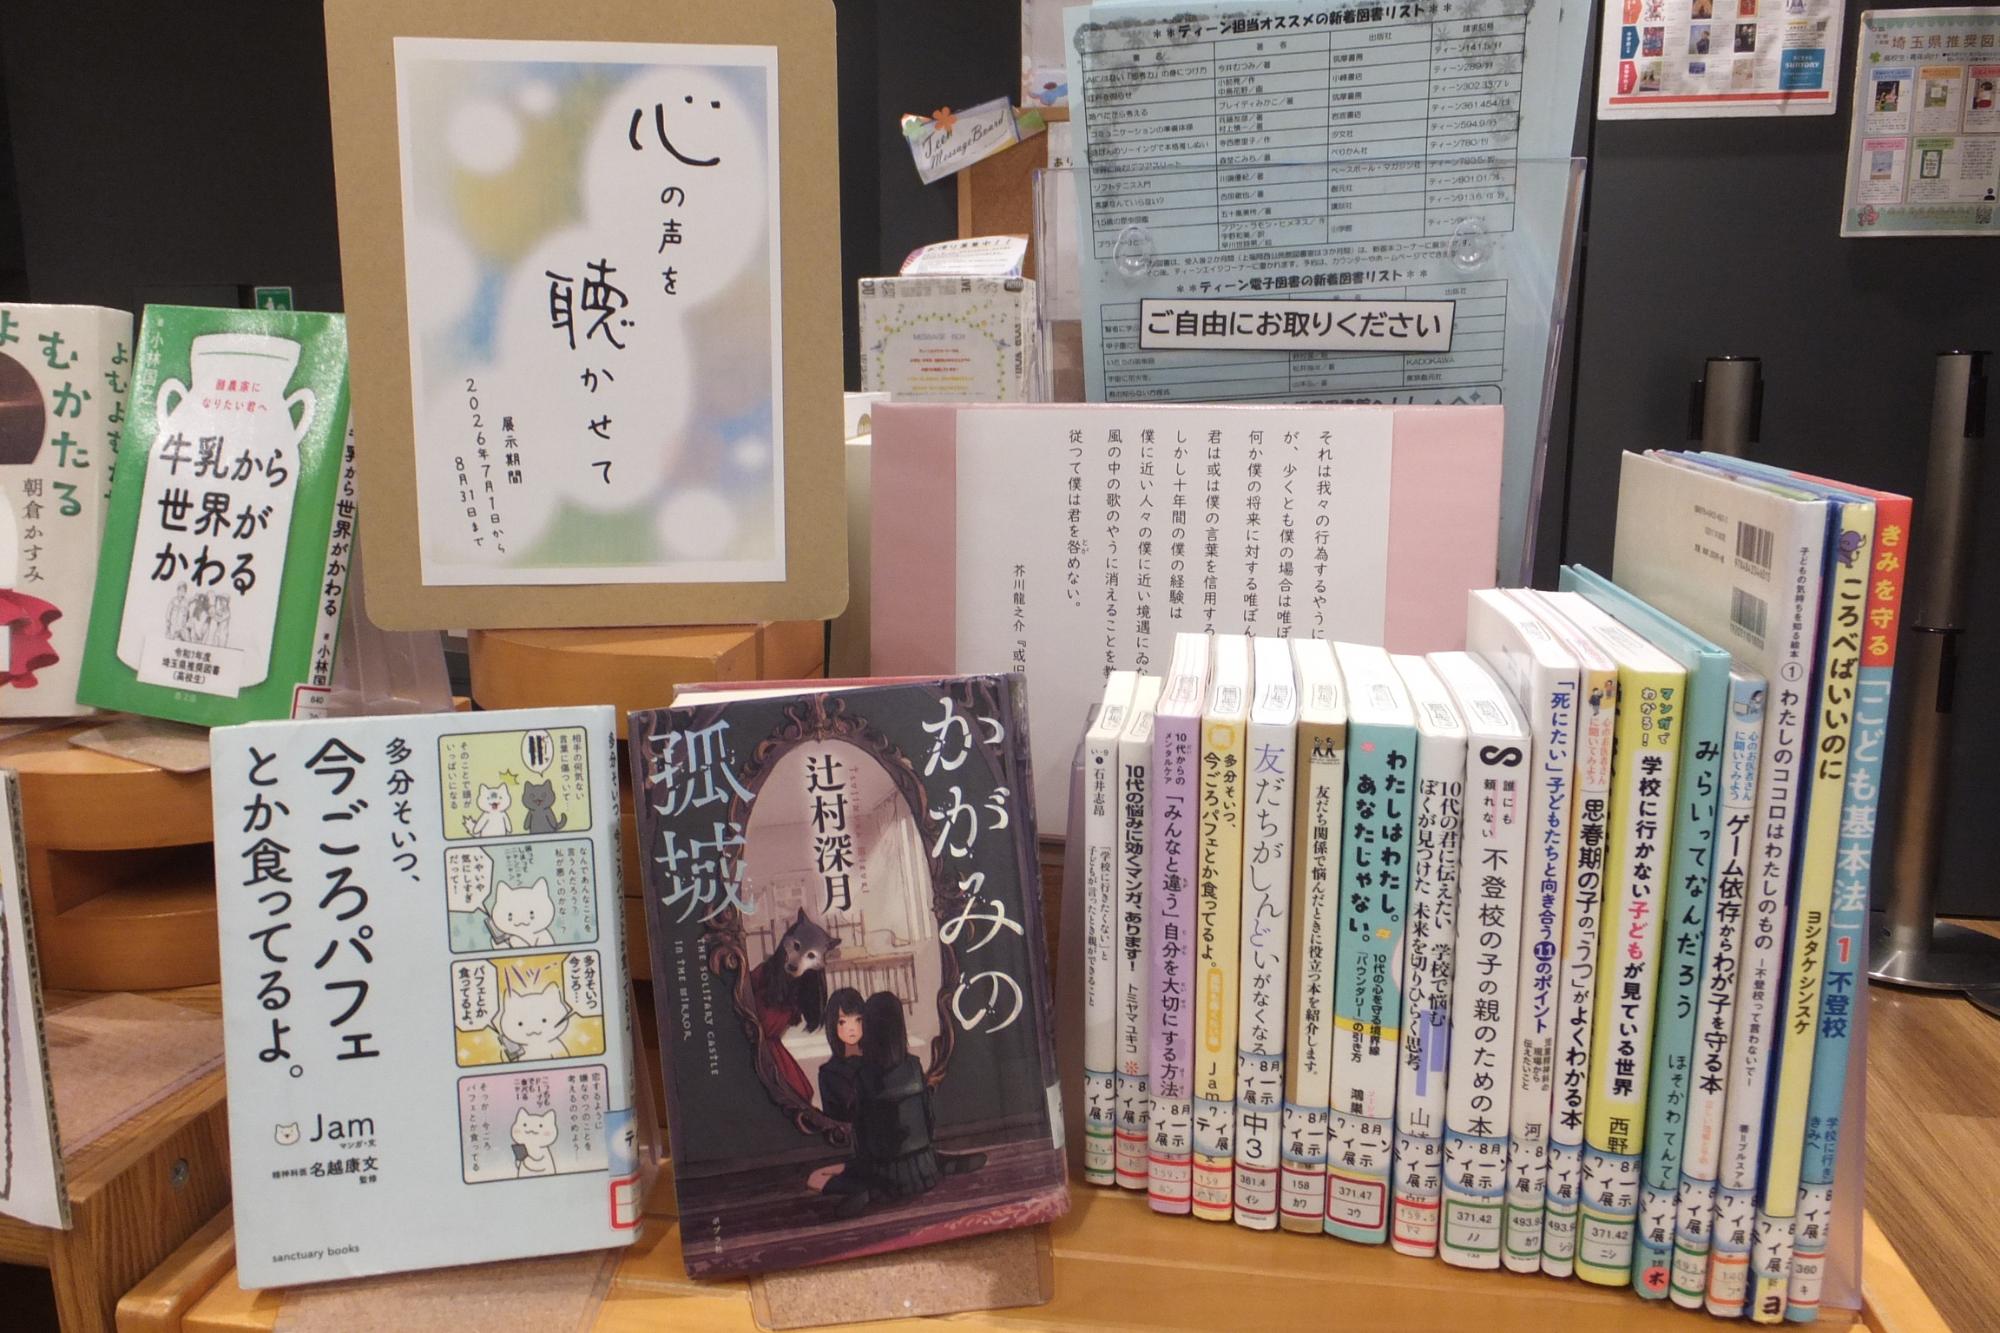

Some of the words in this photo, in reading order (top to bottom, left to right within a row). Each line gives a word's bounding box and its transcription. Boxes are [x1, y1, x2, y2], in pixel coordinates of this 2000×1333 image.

[628, 94, 721, 297] 心の声を
[544, 258, 636, 486] 聴かせて
[1147, 308, 1441, 340] ご自由にお取りください
[156, 488, 273, 539] 世界が
[158, 434, 289, 488] 牛乳から
[500, 416, 524, 486] 展示期間
[21, 477, 44, 583] 朝倉かすみ
[150, 541, 256, 596] かわる
[1169, 429, 1189, 619] しかし十年間の僕の経験は
[1867, 523, 1902, 657] きみを守る
[1657, 687, 1675, 746] マンガで
[1818, 577, 1863, 782] ころべばいいのに
[384, 736, 422, 884] 多分そいつ、
[647, 717, 758, 926] 孤城
[806, 753, 855, 915] 辻村深月
[921, 695, 1025, 1034] かがみの
[1349, 773, 1377, 943] あなたじゃない。
[1379, 749, 1408, 923] わたしはわたし。
[1482, 779, 1497, 839] 頼れない
[1502, 780, 1515, 826] 誰にも
[1754, 687, 1799, 951] わたしのココロはわたしのもの
[241, 745, 304, 1079] とか食ってるよ。
[304, 736, 381, 1062] 今ごろパフェ
[1611, 755, 1664, 1099] 学校に行かない子どもが見ている世界
[1674, 739, 1720, 1020] みらいってなんだろう
[583, 955, 598, 1010] 多分そいつ
[1468, 848, 1509, 1137] 不登校の子の親のための本
[1698, 813, 1751, 1096] ゲーム依存からわが子を守る本
[1793, 910, 1823, 1035] ヨシタケシンスケ
[1821, 970, 1855, 1040] 不登校
[310, 1113, 375, 1143] Jam
[1664, 1054, 1688, 1124] ほそかわ
[309, 1155, 380, 1178] 名越康文
[1339, 1185, 1373, 1201] 371.47
[1456, 1213, 1492, 1225] 371.42
[272, 1248, 324, 1264] sanctuary
[327, 1243, 361, 1257] books
[1591, 1227, 1630, 1242] 371.42
